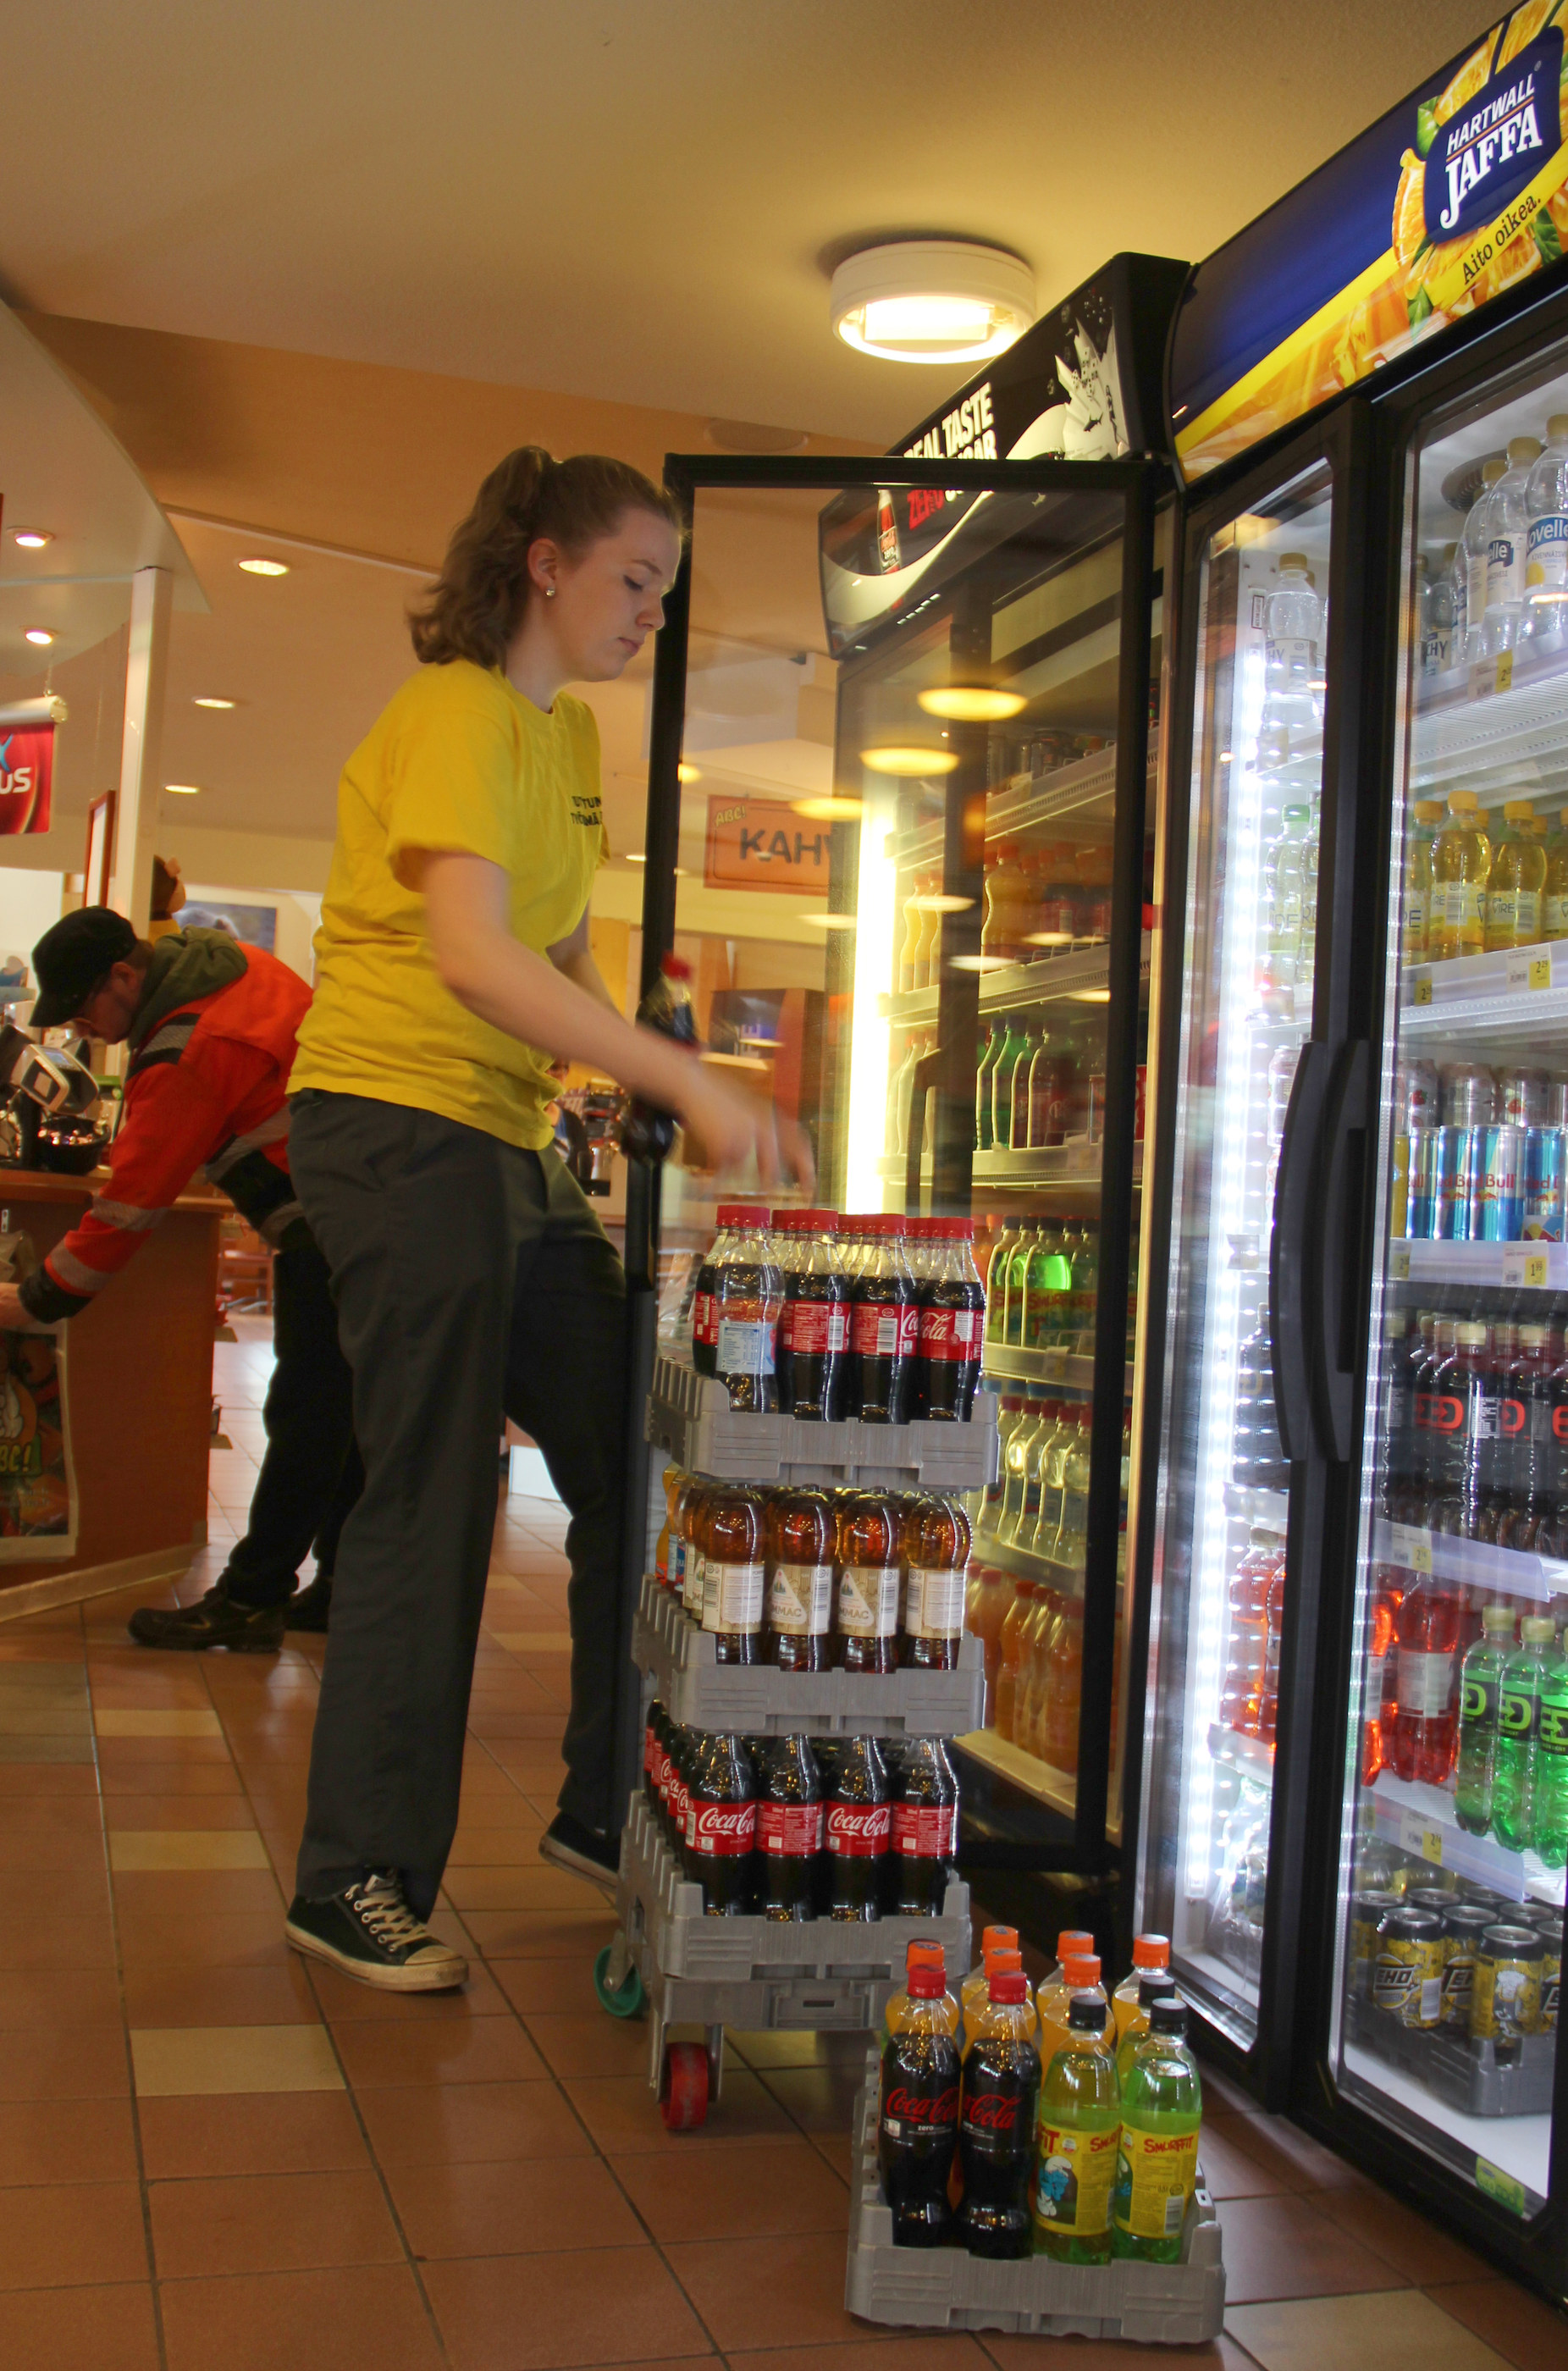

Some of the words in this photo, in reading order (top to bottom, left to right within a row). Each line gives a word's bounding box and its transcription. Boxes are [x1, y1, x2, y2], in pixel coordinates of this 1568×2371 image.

[1446, 73, 1535, 157] HARTWALL
[1439, 102, 1543, 230] JAFFA
[1461, 243, 1493, 285] Aito
[1495, 195, 1542, 247] oikea.
[903, 426, 945, 458] EAL
[941, 381, 994, 458] TASTE
[715, 805, 746, 827] ABC!
[1486, 1174, 1517, 1189] Bull
[1144, 2136, 1195, 2154] SMURFFIT
